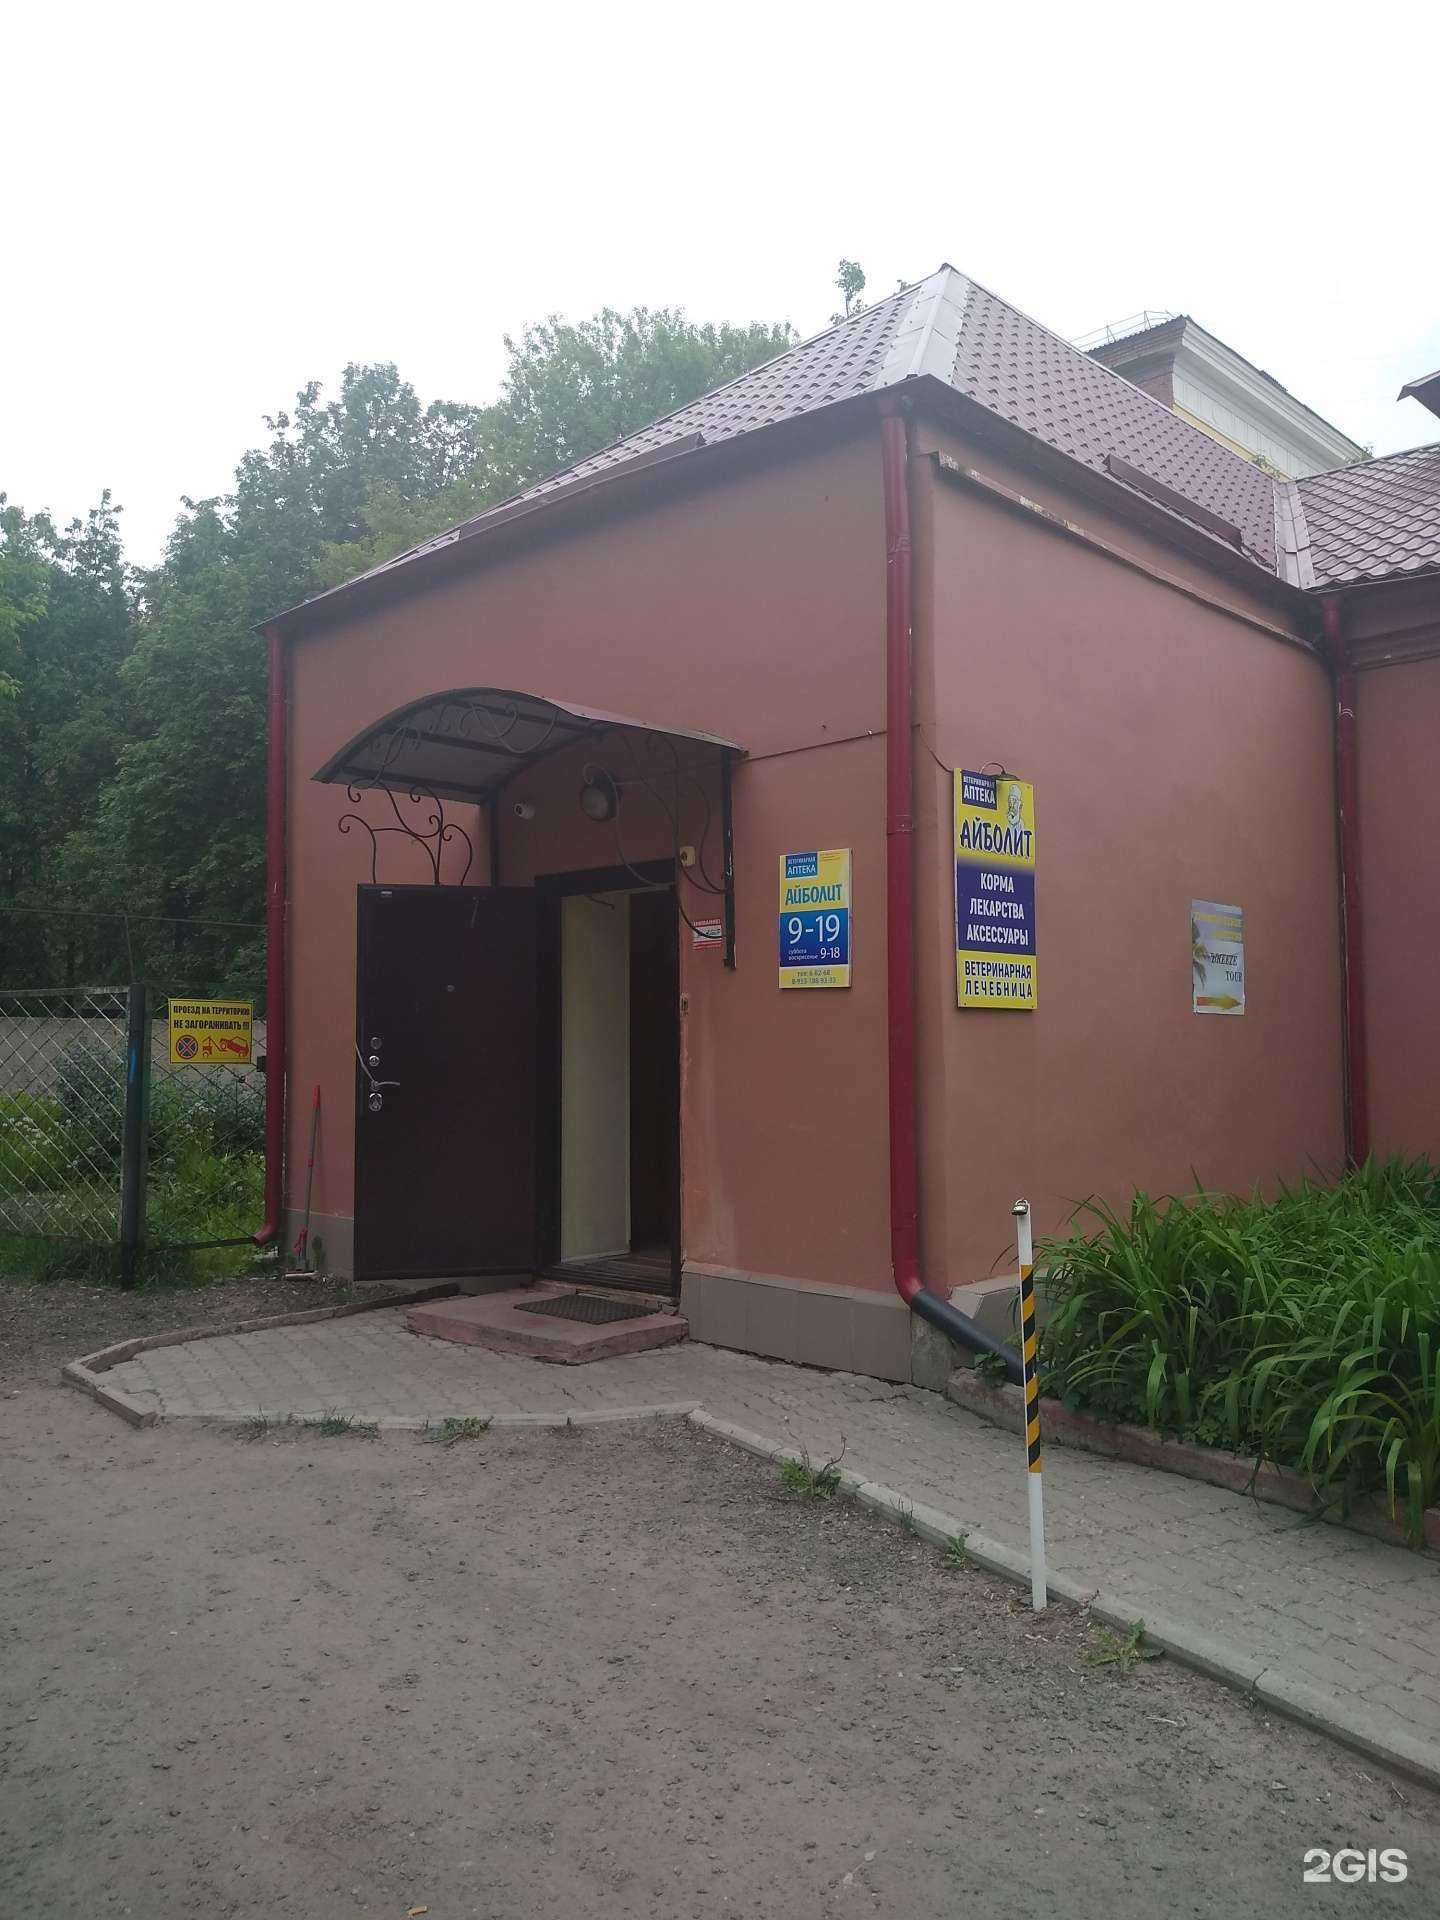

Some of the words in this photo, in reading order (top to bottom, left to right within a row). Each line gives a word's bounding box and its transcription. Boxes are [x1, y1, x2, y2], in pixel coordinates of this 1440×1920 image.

[963, 784, 996, 804] АПТЕКА
[960, 816, 1033, 858] АЙБОЛИТ
[788, 865, 816, 875] АПТЕКА
[981, 873, 1014, 893] КОРМА
[785, 884, 842, 906] АЙБОЛИТ
[970, 898, 1025, 920] ЛЕКАРСТВА
[788, 914, 840, 944] 9-19
[967, 924, 1029, 946] АКСЕССУАРЫ
[820, 947, 840, 959] 9-18
[965, 961, 1032, 979] ВЕТЕРИНАРНАЯ
[965, 980, 1033, 999] ЛЕЧЕБНИЦА
[173, 1005, 200, 1015] ПРОЕЗД
[201, 1006, 211, 1015] НА
[212, 1006, 250, 1015] ТЕРРИТОРИЮ
[173, 1020, 183, 1029] НЕ
[184, 1020, 242, 1030] ЗАГОРАЖИВАТЬ
